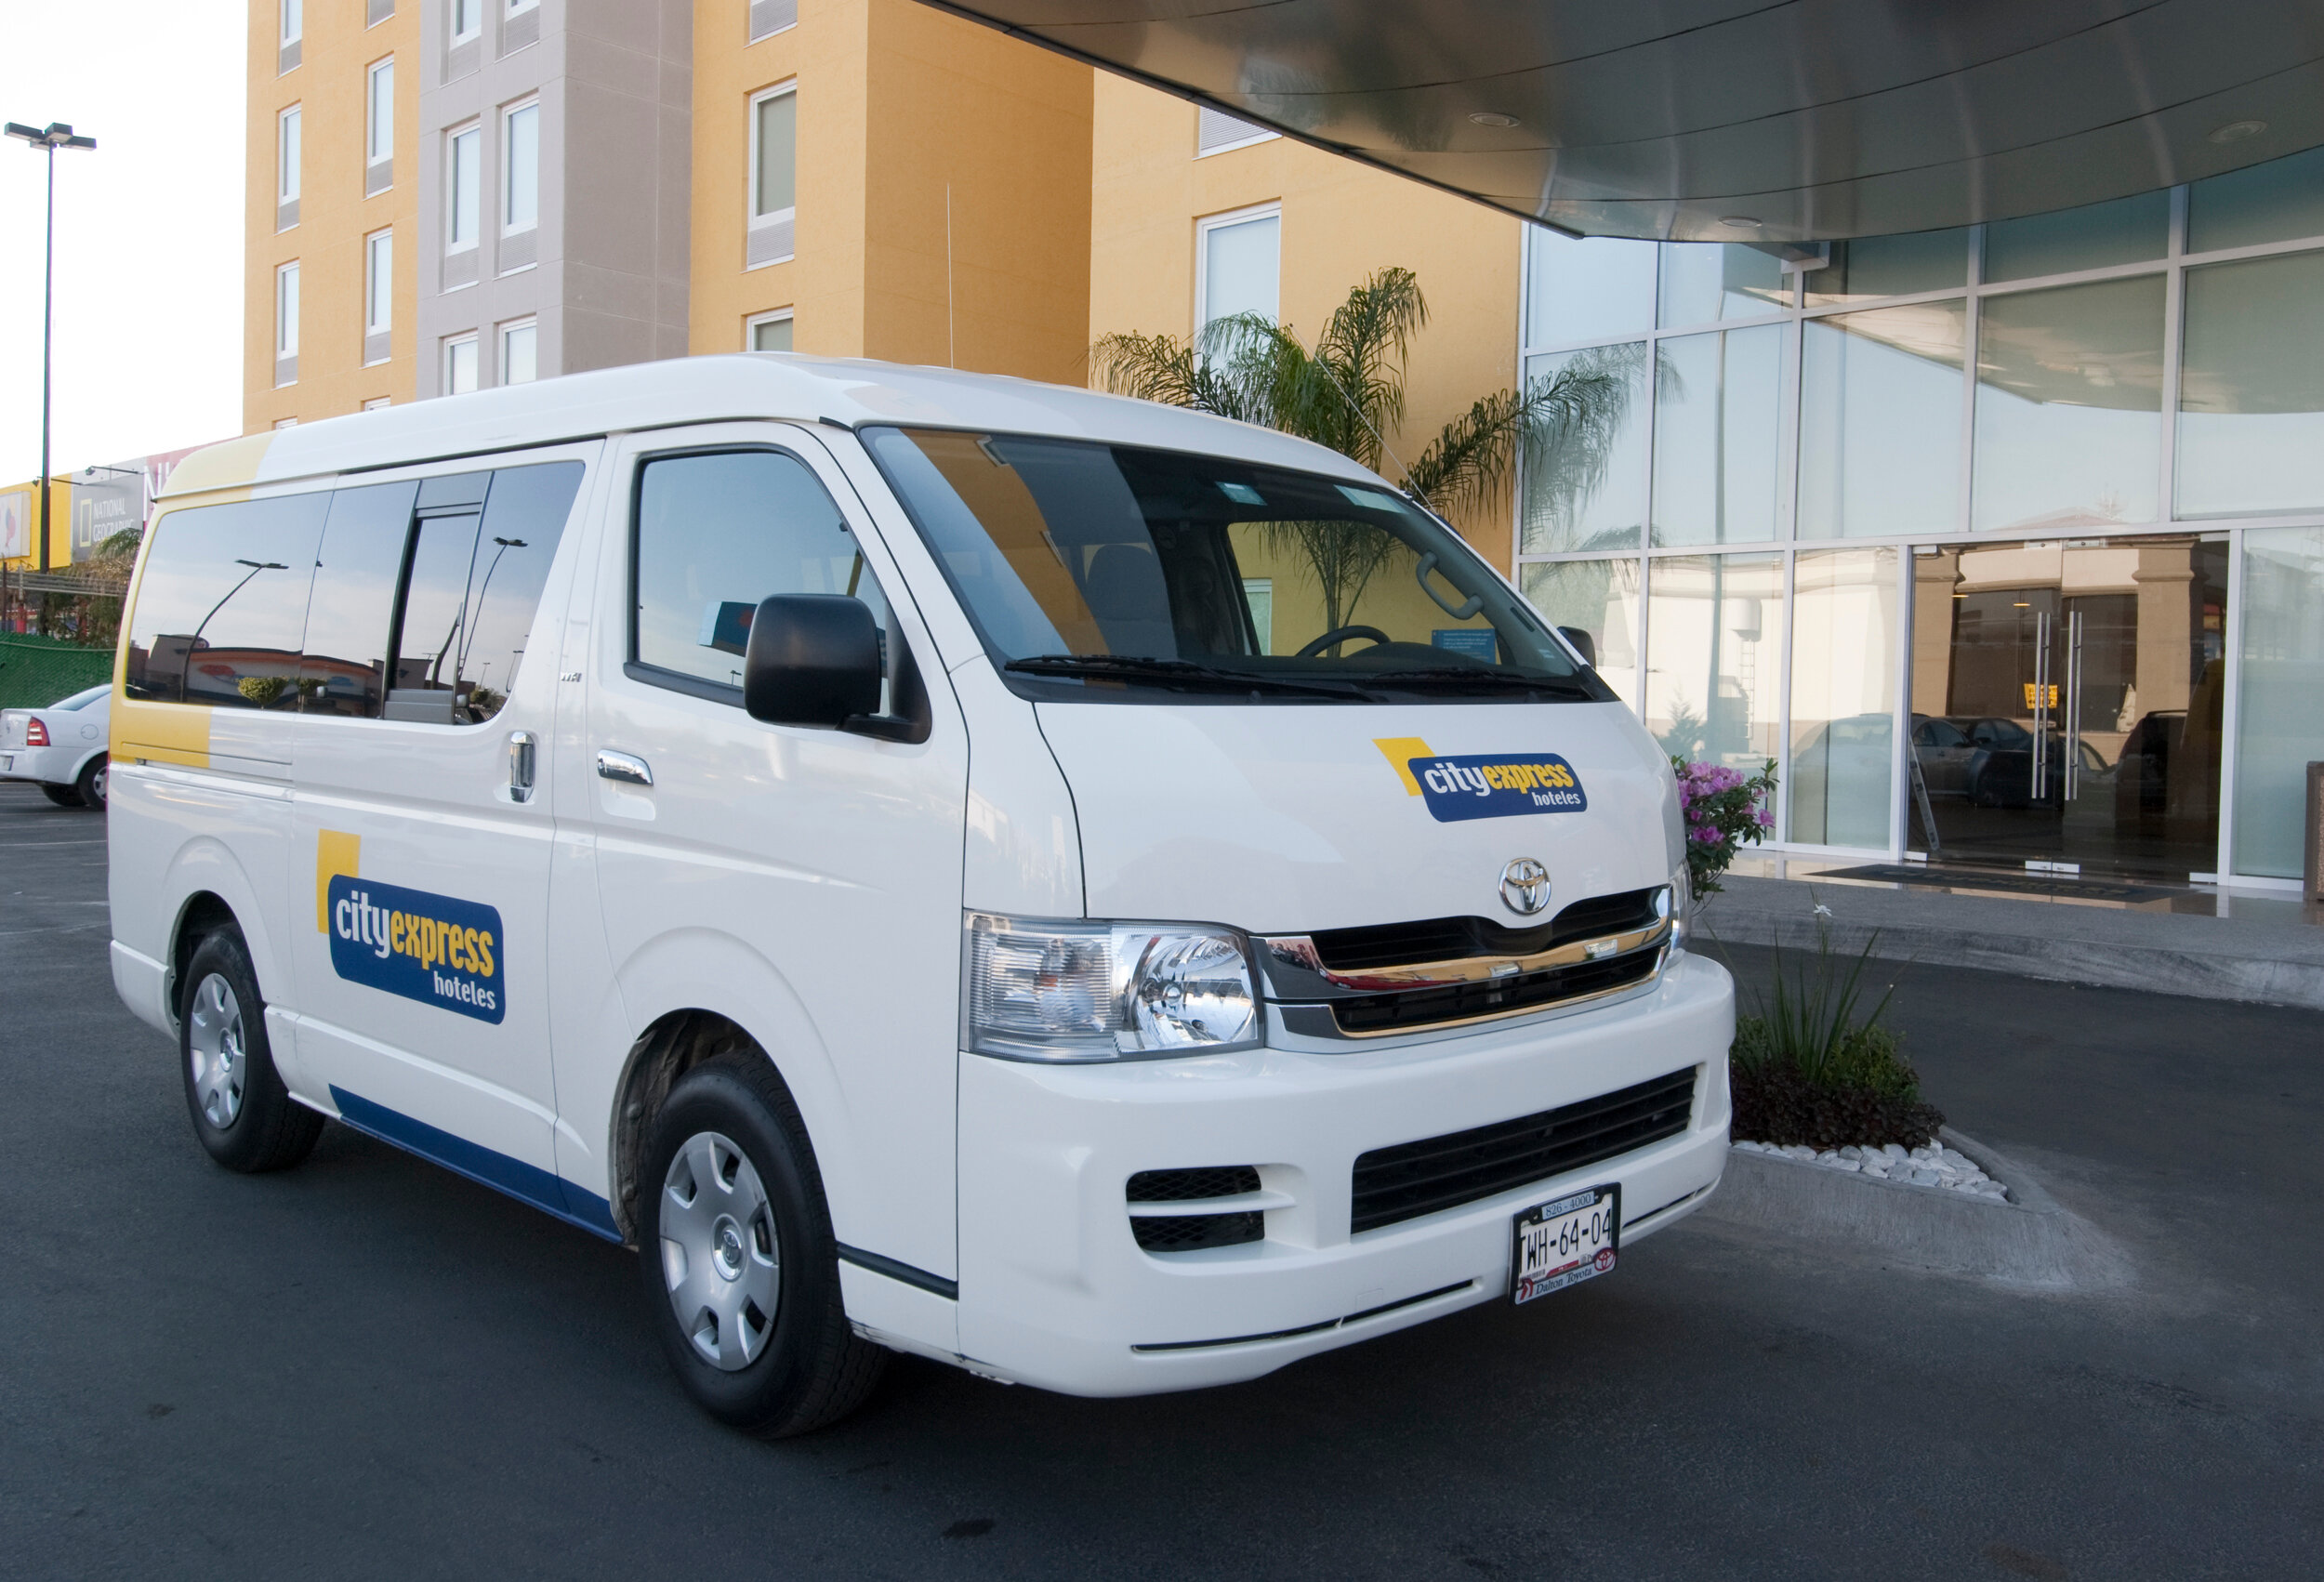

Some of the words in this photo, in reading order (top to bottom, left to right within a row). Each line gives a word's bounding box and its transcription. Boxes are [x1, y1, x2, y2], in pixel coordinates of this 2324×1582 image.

[94, 498, 125, 519] NATIONAL
[1424, 762, 1575, 797] cityexpress
[1531, 791, 1581, 806] hoteles
[336, 890, 495, 977] cityexpress
[433, 970, 496, 1010] hoteles
[1536, 1278, 1564, 1295] Dalton
[1565, 1268, 1592, 1284] Toyota
